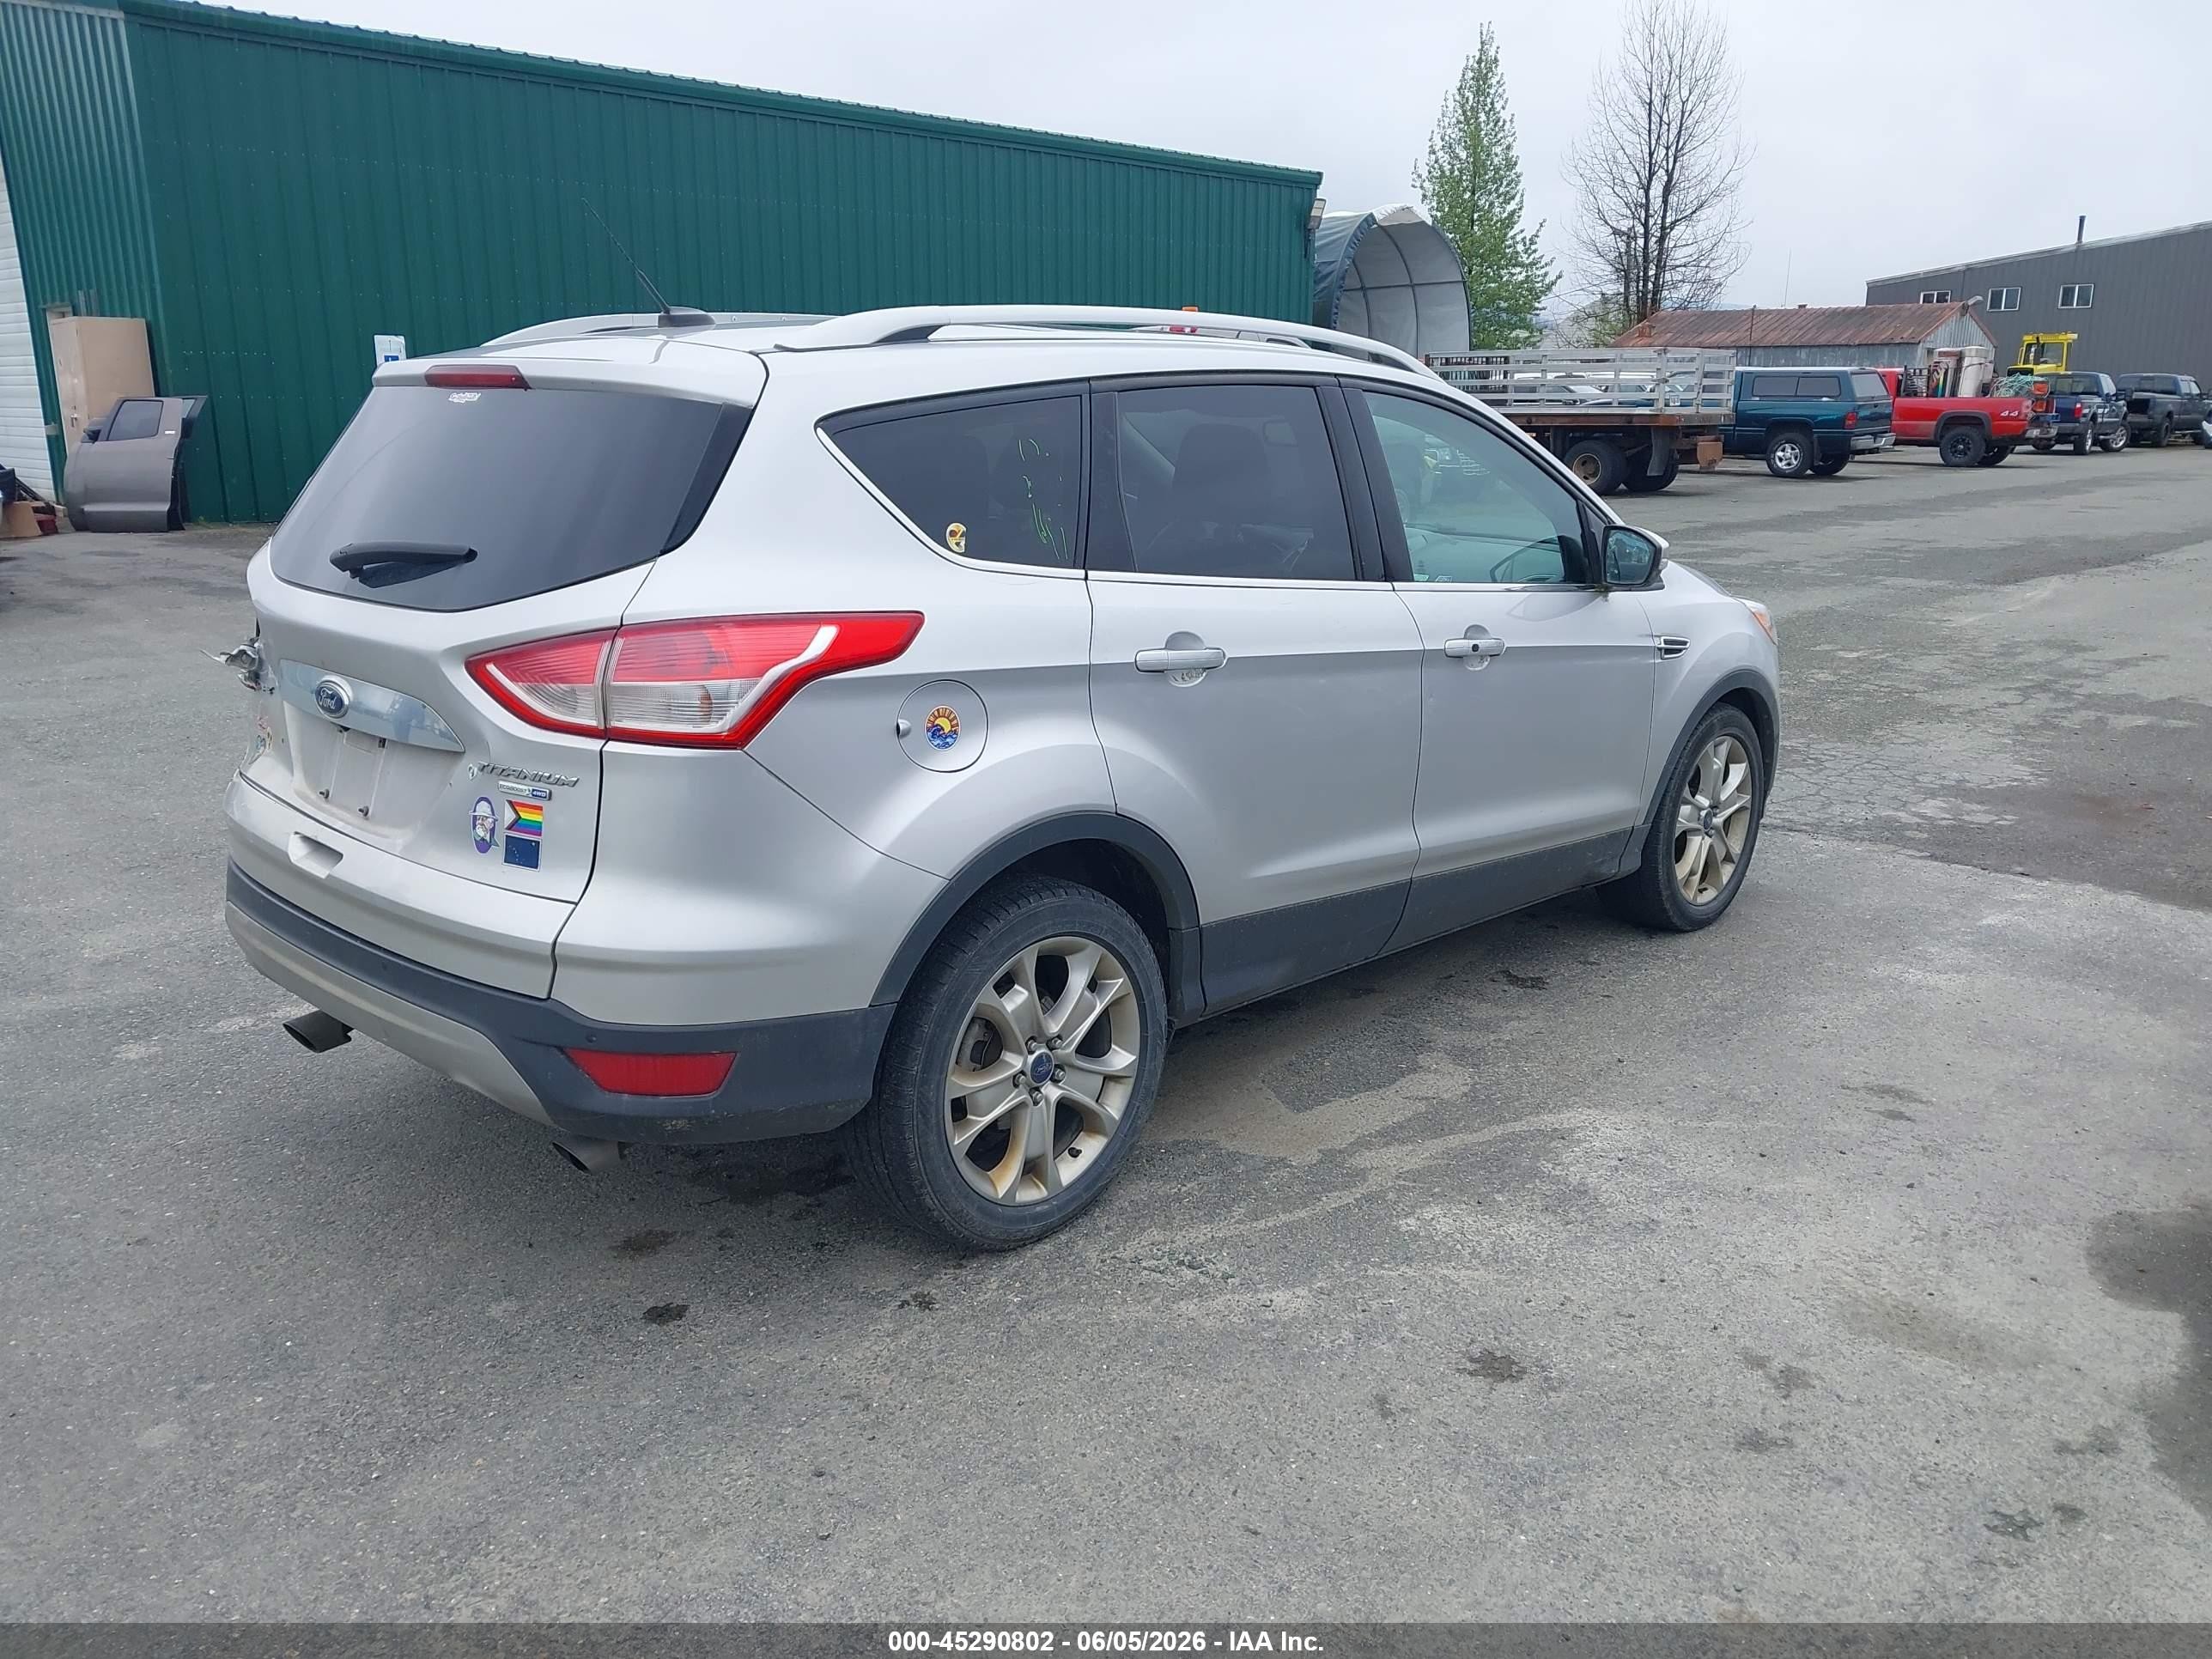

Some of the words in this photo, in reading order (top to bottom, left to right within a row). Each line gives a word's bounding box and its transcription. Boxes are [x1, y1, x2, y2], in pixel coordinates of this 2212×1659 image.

[319, 687, 337, 709] Ford
[477, 762, 580, 787] TITANIUM
[499, 783, 527, 793] ECOBOOST
